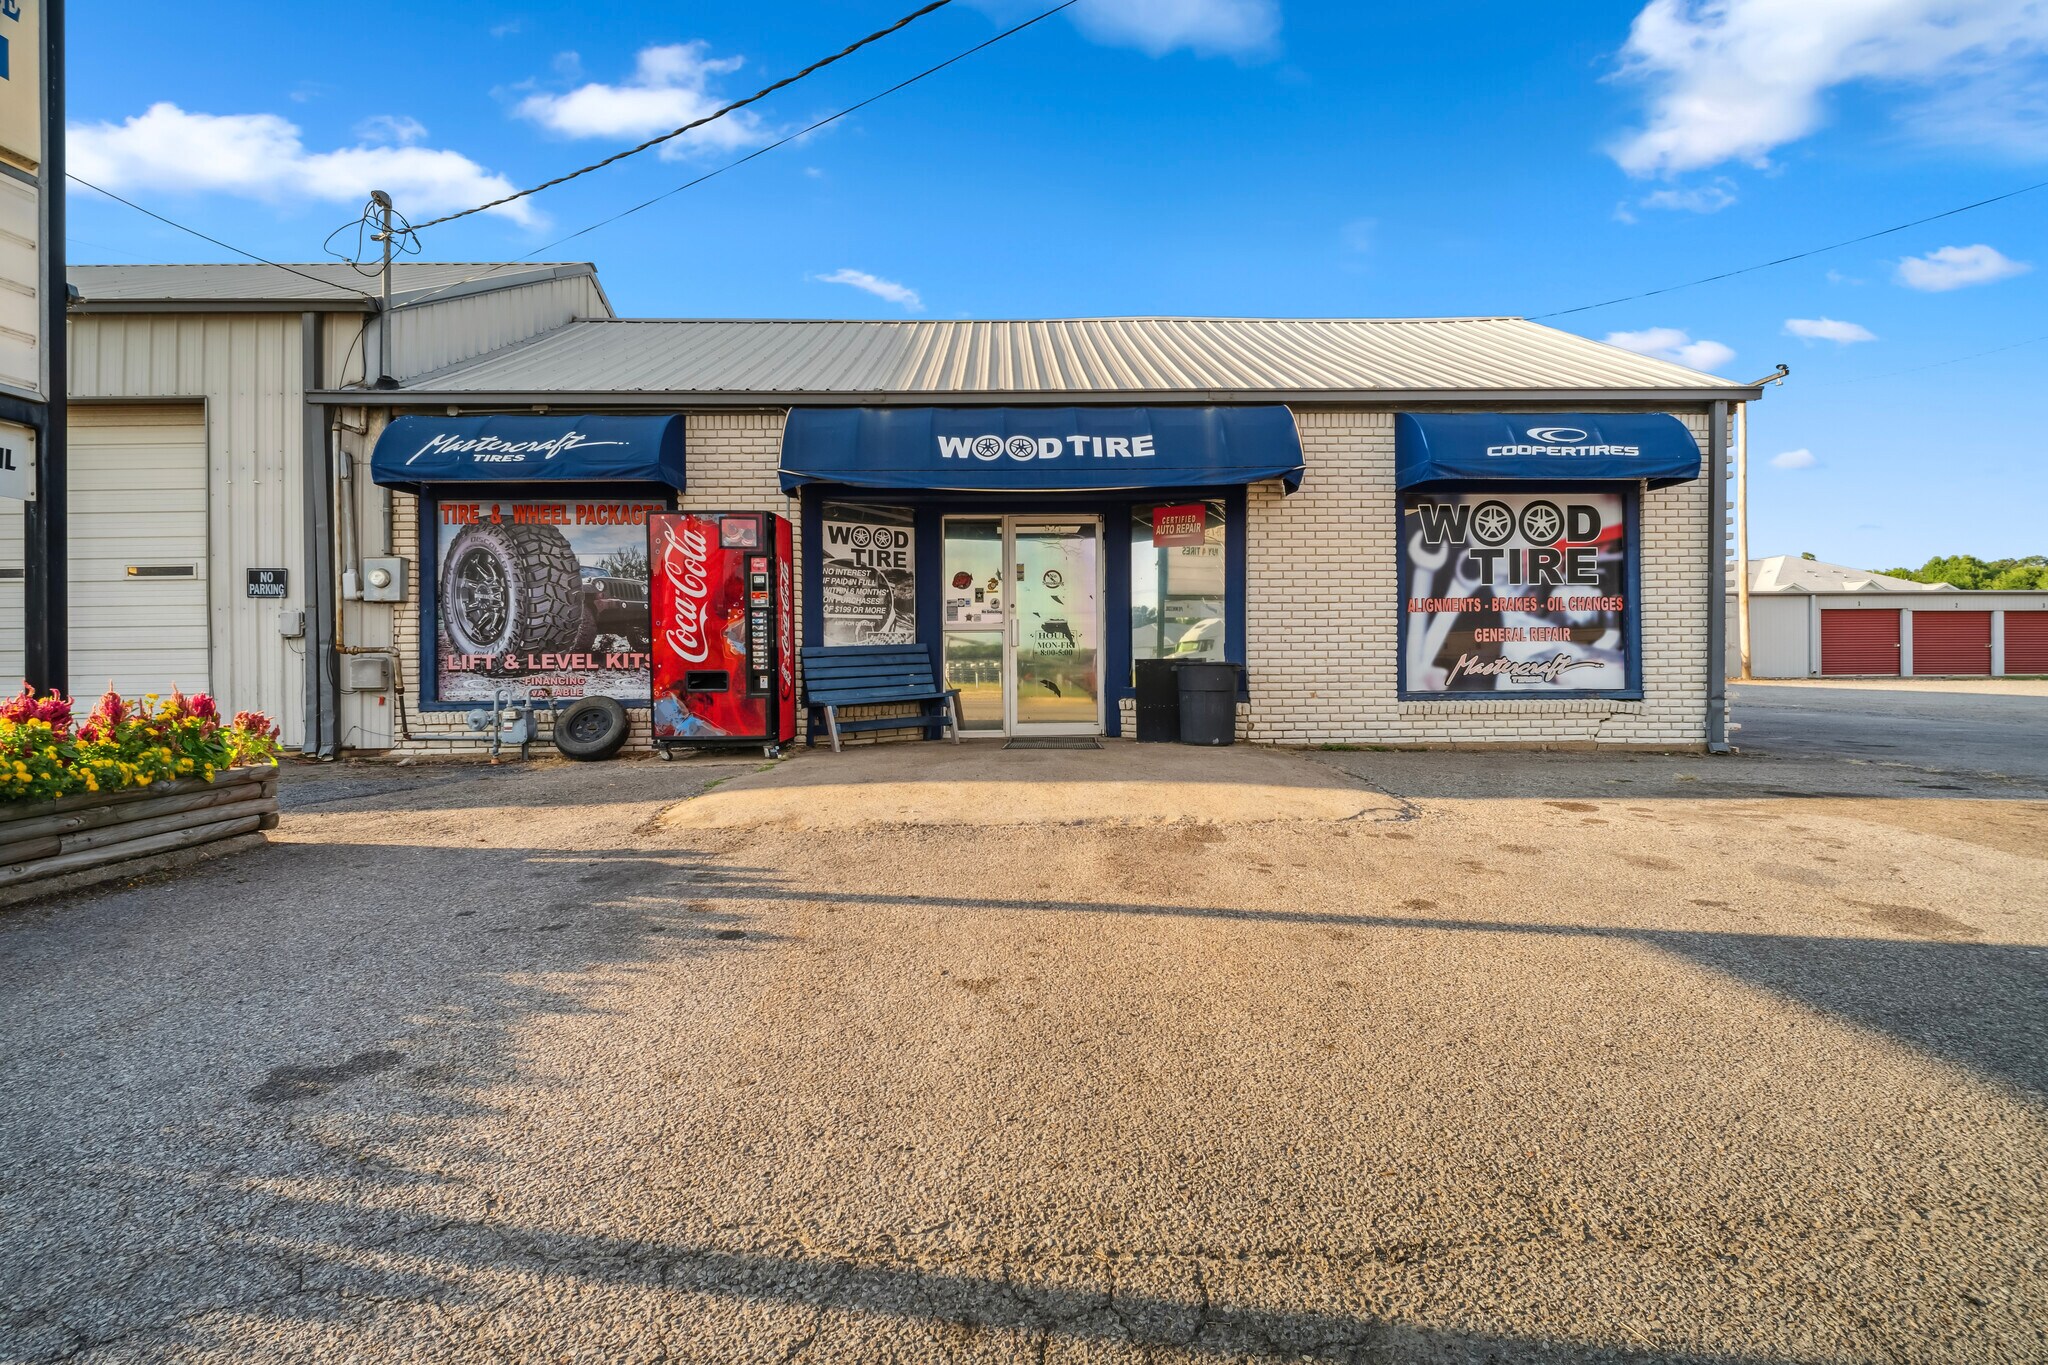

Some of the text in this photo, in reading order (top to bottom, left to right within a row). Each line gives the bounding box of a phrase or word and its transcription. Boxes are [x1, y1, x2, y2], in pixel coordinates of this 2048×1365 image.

[406, 431, 622, 466] Mastercraft
[938, 434, 1156, 462] WOOD TIRE
[473, 454, 526, 462] TIRES
[440, 504, 480, 526] TIRE
[490, 504, 503, 526] &
[512, 504, 572, 526] WHEEL
[1162, 515, 1196, 525] CERTIFIED
[1418, 500, 1603, 547] WOOD
[827, 525, 909, 549] WOOD
[1155, 524, 1175, 536] AUTO
[1176, 522, 1202, 534] REPAIR
[850, 548, 907, 569] TIRE
[1468, 548, 1599, 586] TIRE
[260, 571, 274, 583] NO
[831, 577, 848, 585] PAID
[835, 568, 871, 577] INTEREST
[249, 583, 285, 595] PARKING
[664, 520, 708, 663] Coca-Cola
[823, 586, 849, 594] WITHIN
[1407, 597, 1481, 613] ALIGNMENTS
[1491, 597, 1537, 611] BRAKES
[1547, 597, 1566, 611] OIL
[1568, 596, 1624, 611] CHANGES
[1474, 627, 1571, 642] GENERAL REPAIR
[448, 654, 496, 671] LIFT
[504, 653, 520, 670] &
[528, 653, 600, 670] LEVEL
[1446, 653, 1600, 686] Mastercraft
[525, 677, 586, 686] FINANCING
